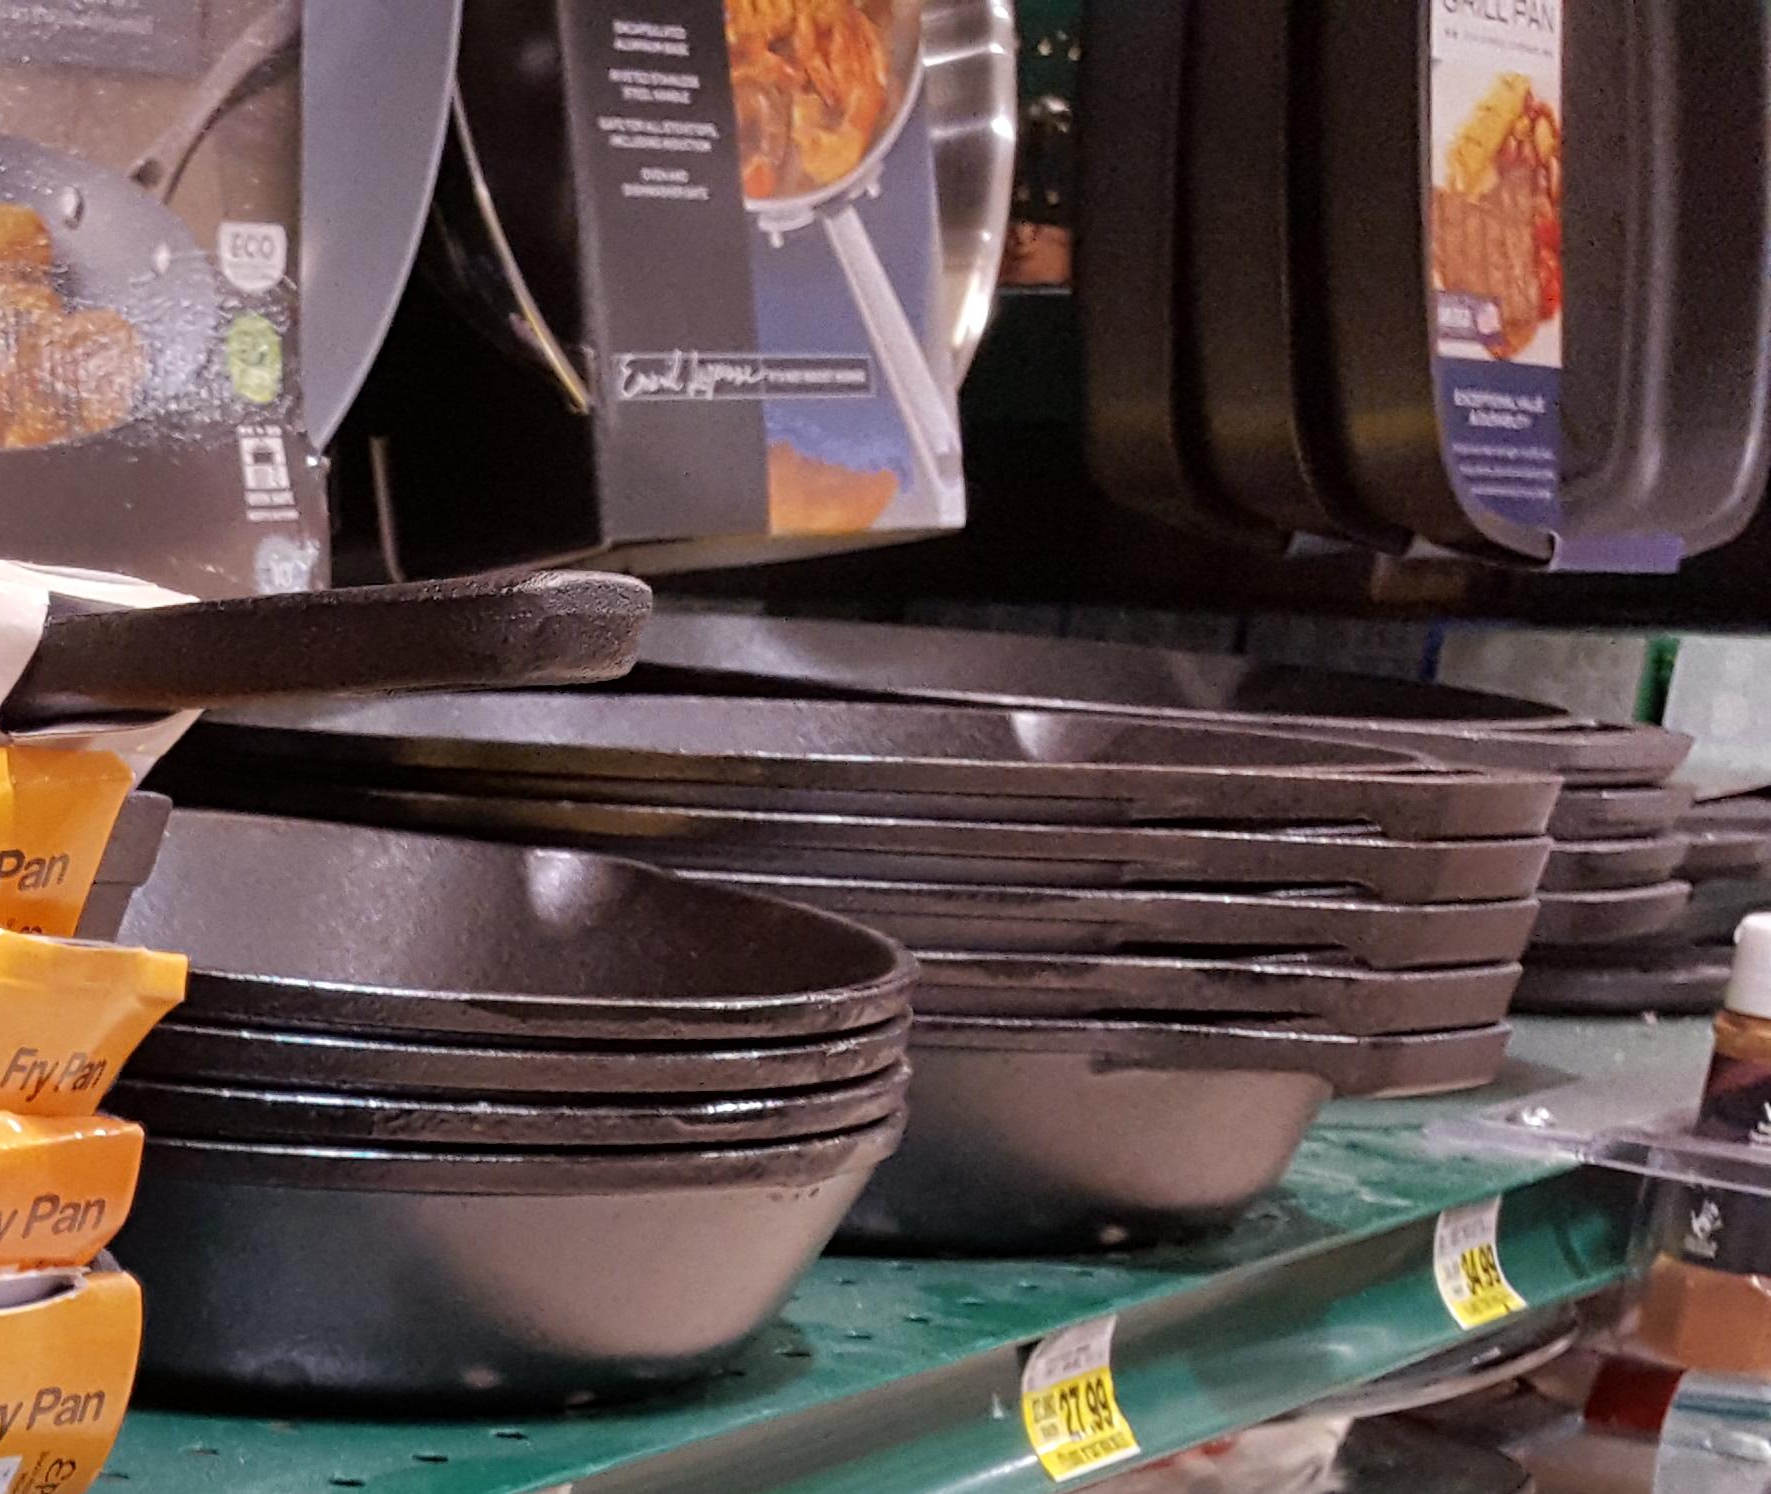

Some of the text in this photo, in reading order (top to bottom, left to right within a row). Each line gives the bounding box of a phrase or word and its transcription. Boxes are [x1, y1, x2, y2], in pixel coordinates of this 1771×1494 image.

[0, 1046, 55, 1102] Fry
[59, 1052, 108, 1089] Pan
[24, 1193, 107, 1241] Pan
[25, 1385, 107, 1432] Pan
